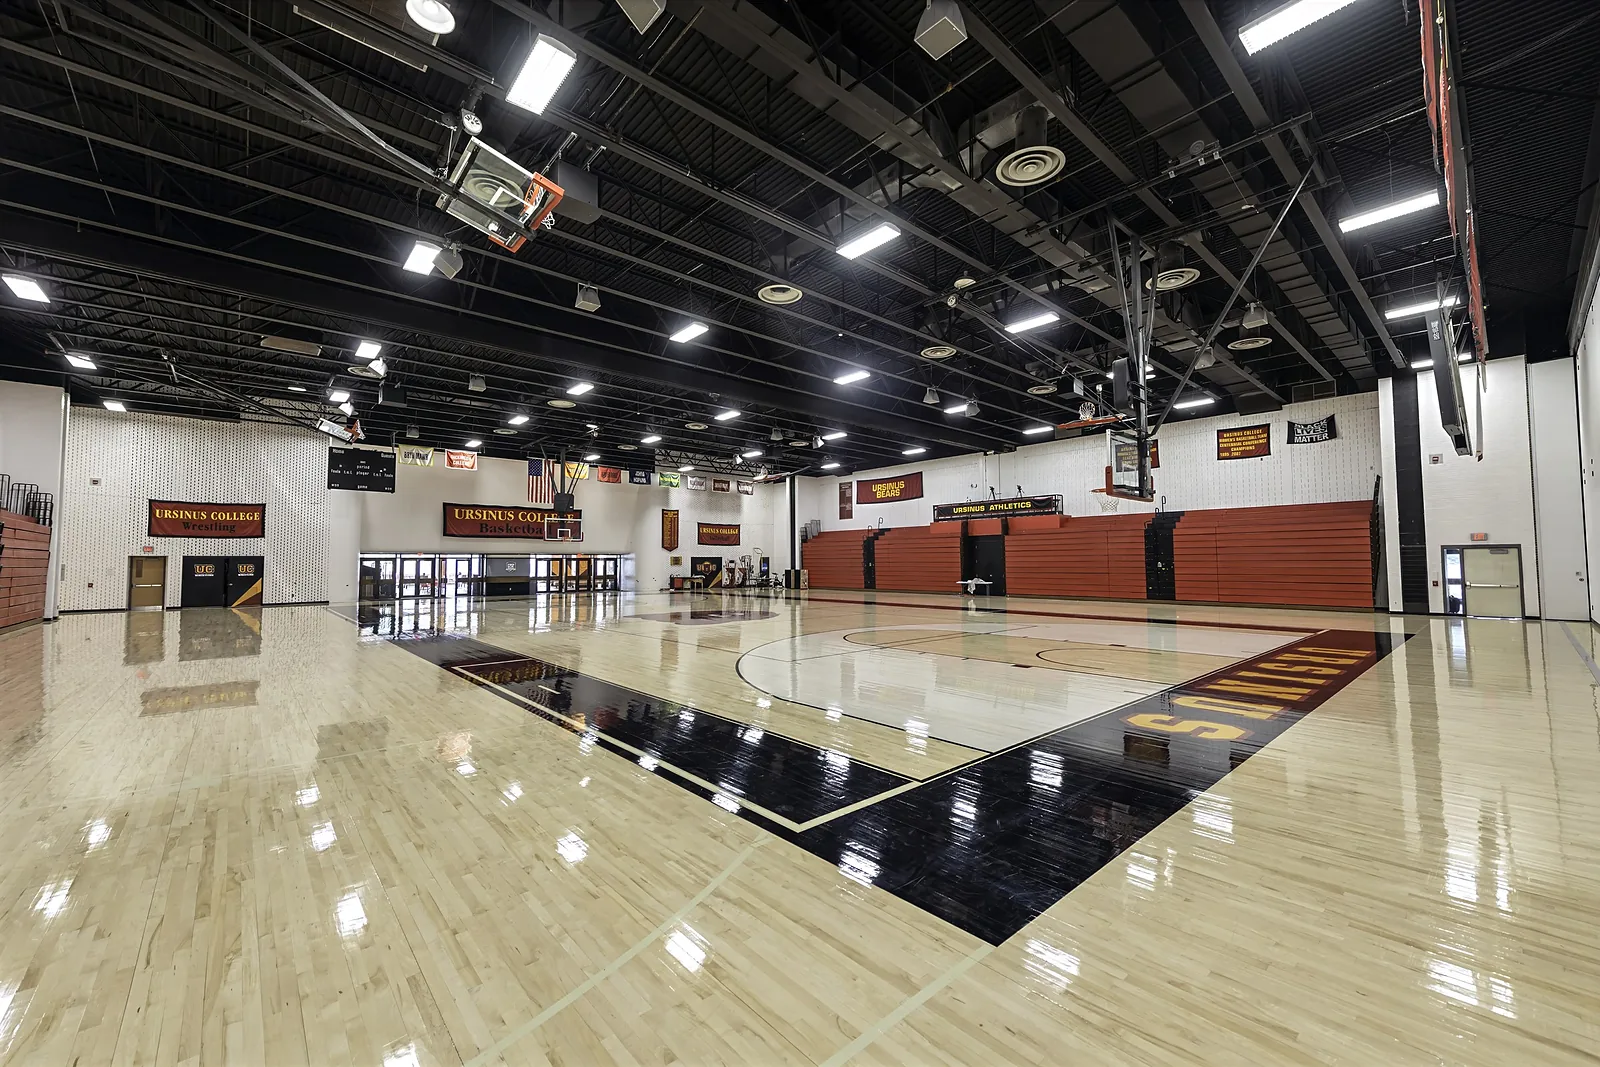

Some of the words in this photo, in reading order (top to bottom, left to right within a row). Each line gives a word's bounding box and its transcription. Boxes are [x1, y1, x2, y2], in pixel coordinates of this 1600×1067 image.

[1294, 424, 1328, 437] LIVES
[1294, 433, 1330, 443] MATTER
[872, 481, 905, 492] URSINUS
[876, 489, 901, 499] BEARS
[953, 504, 985, 514] URSINUS
[989, 501, 1032, 511] ATHLETICS
[155, 509, 207, 520] URSINUS
[210, 511, 260, 521] COLLEGE
[453, 509, 515, 521] URSINUS
[518, 511, 575, 524] COLLEE
[182, 521, 237, 533] Wrestling
[479, 522, 554, 536] Basketbal
[195, 564, 216, 575] UC
[237, 564, 255, 574] UC
[1123, 646, 1376, 741] URSINUS
